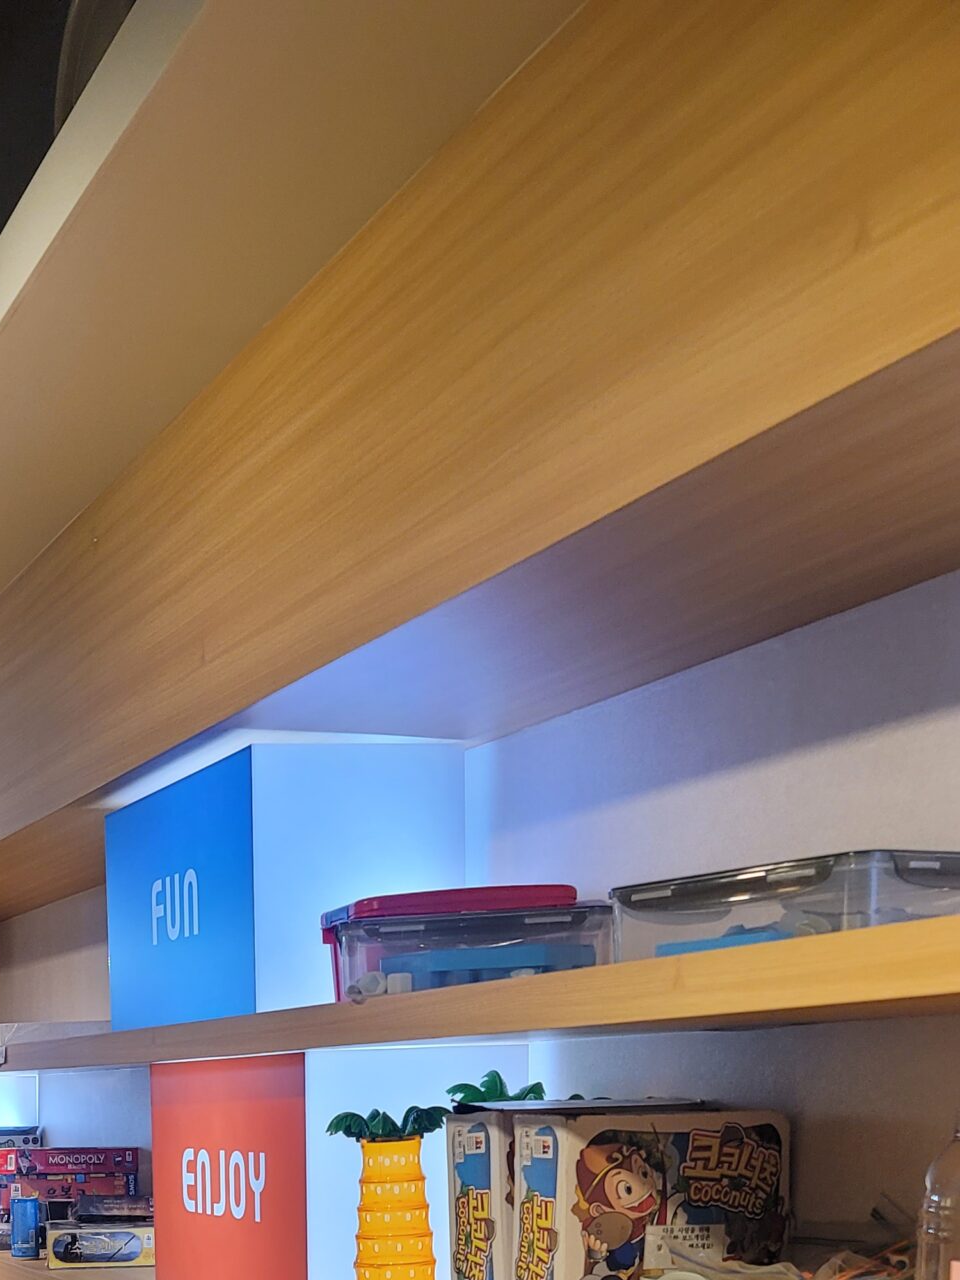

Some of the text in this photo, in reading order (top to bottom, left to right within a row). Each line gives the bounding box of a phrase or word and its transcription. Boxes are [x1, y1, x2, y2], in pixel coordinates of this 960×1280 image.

[150, 867, 199, 945] FUN
[48, 1154, 106, 1164] MONOPOLY
[182, 1147, 266, 1222] ENJOY
